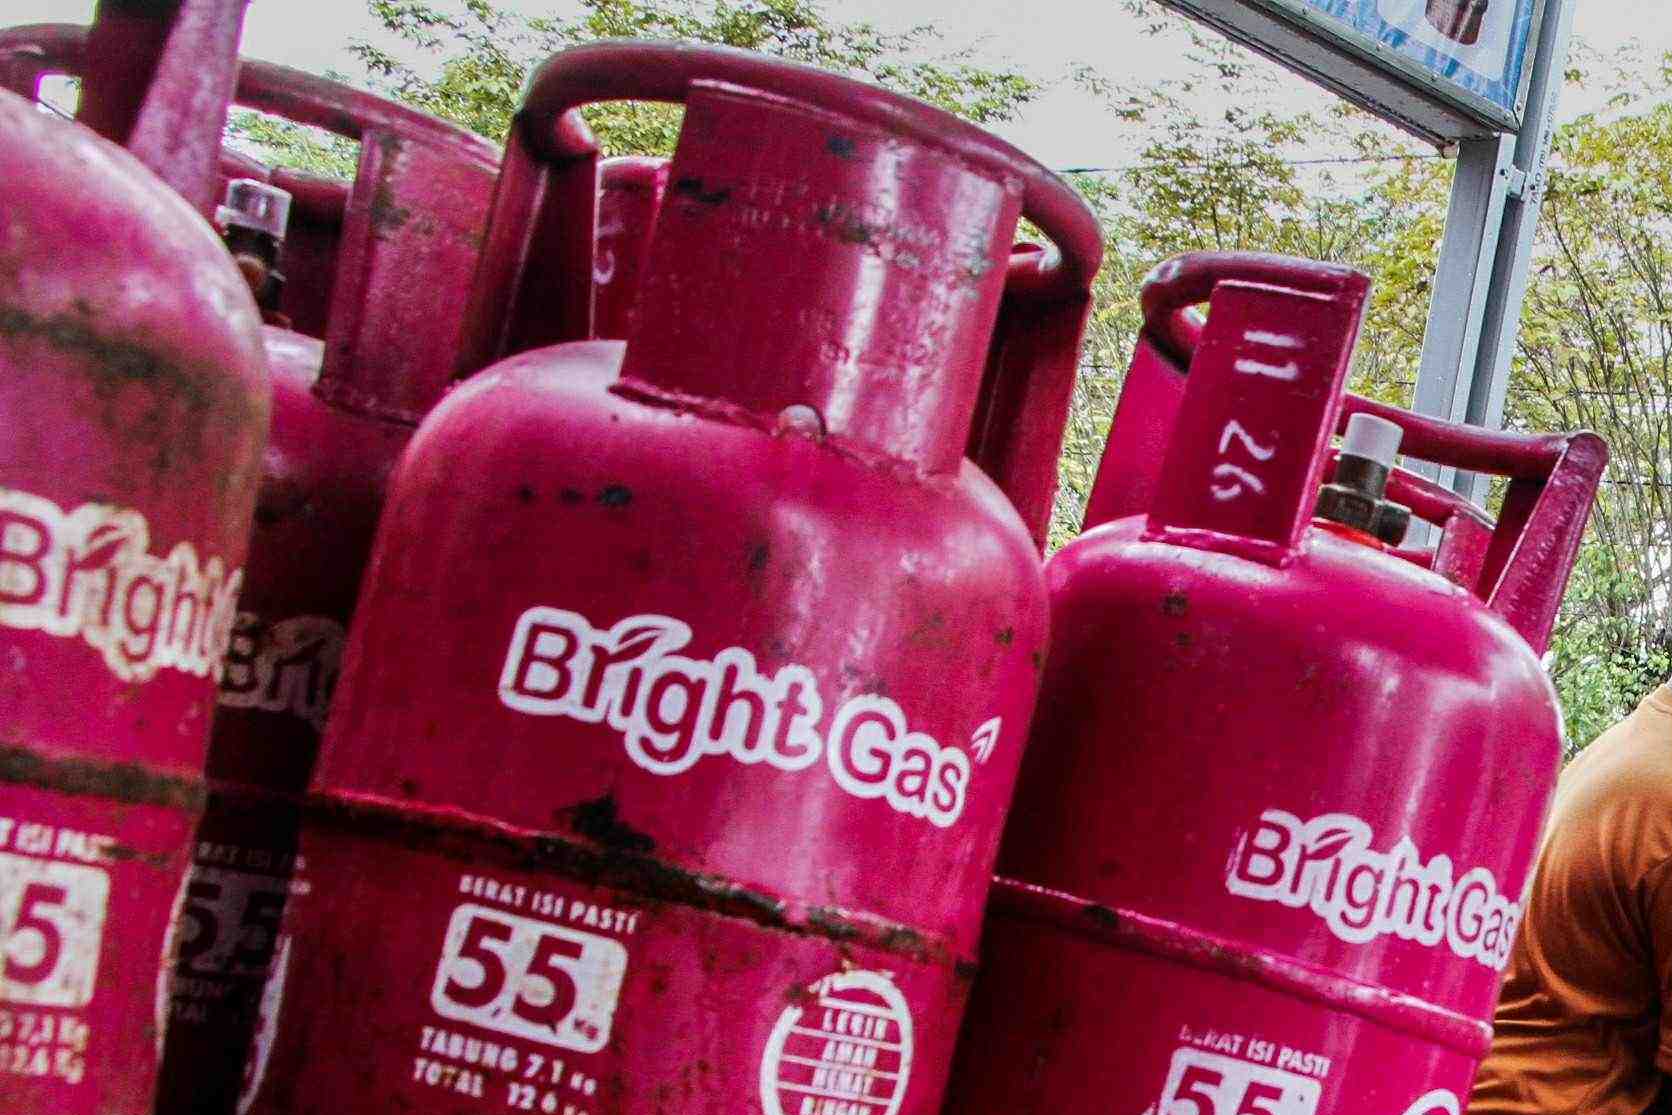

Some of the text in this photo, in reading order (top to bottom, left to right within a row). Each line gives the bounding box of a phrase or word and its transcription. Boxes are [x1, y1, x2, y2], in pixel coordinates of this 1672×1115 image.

[502, 608, 969, 827] Bright Gas
[460, 875, 642, 935] BERAT ISI PASTI
[1229, 811, 1524, 968] Bright Gas
[0, 882, 68, 986] 5
[413, 1057, 484, 1098] TOTAL
[420, 1026, 519, 1072] TABUNG
[1247, 1038, 1275, 1063] ISI
[1277, 1046, 1332, 1078] PASTI
